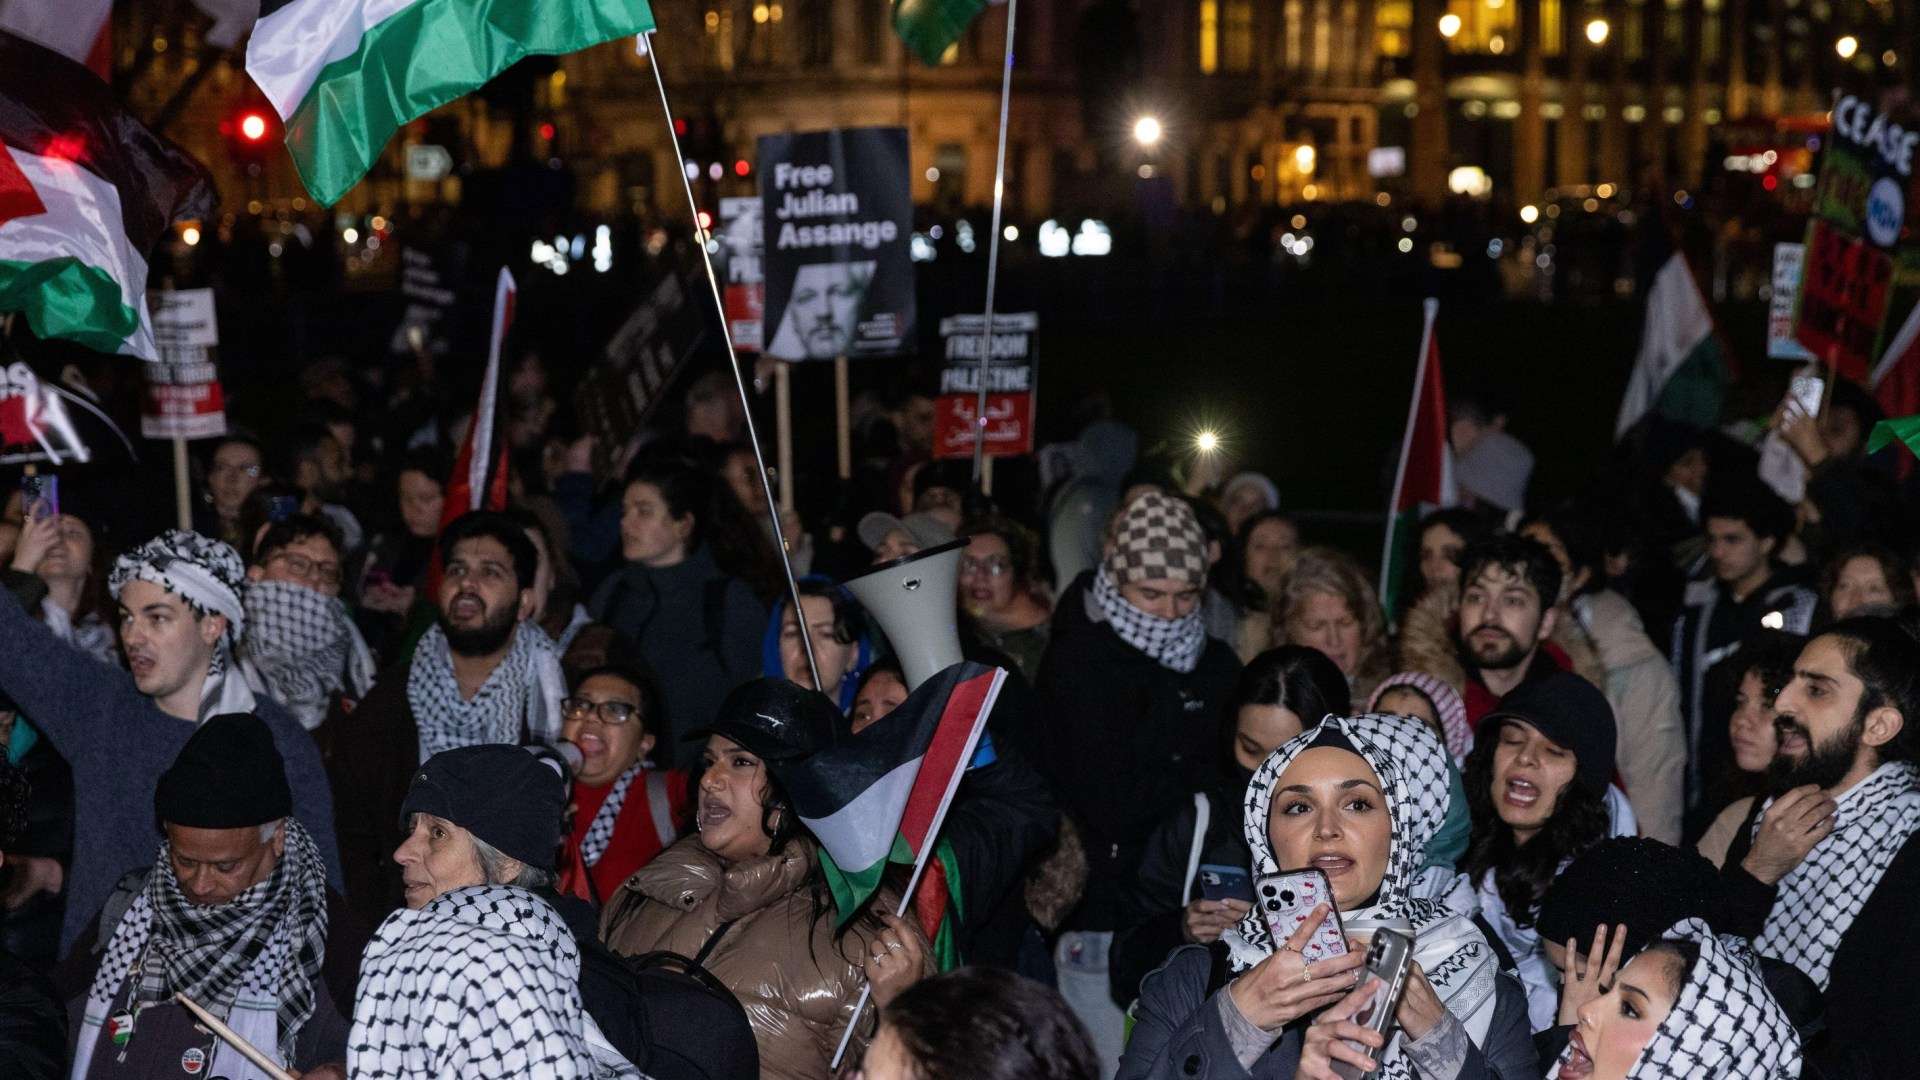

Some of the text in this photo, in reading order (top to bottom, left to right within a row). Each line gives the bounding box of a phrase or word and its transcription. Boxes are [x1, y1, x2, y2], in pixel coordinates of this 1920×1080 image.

[1834, 95, 1920, 176] CEASE
[774, 162, 834, 190] Free
[776, 188, 859, 219] Julian
[776, 220, 898, 249] Assange
